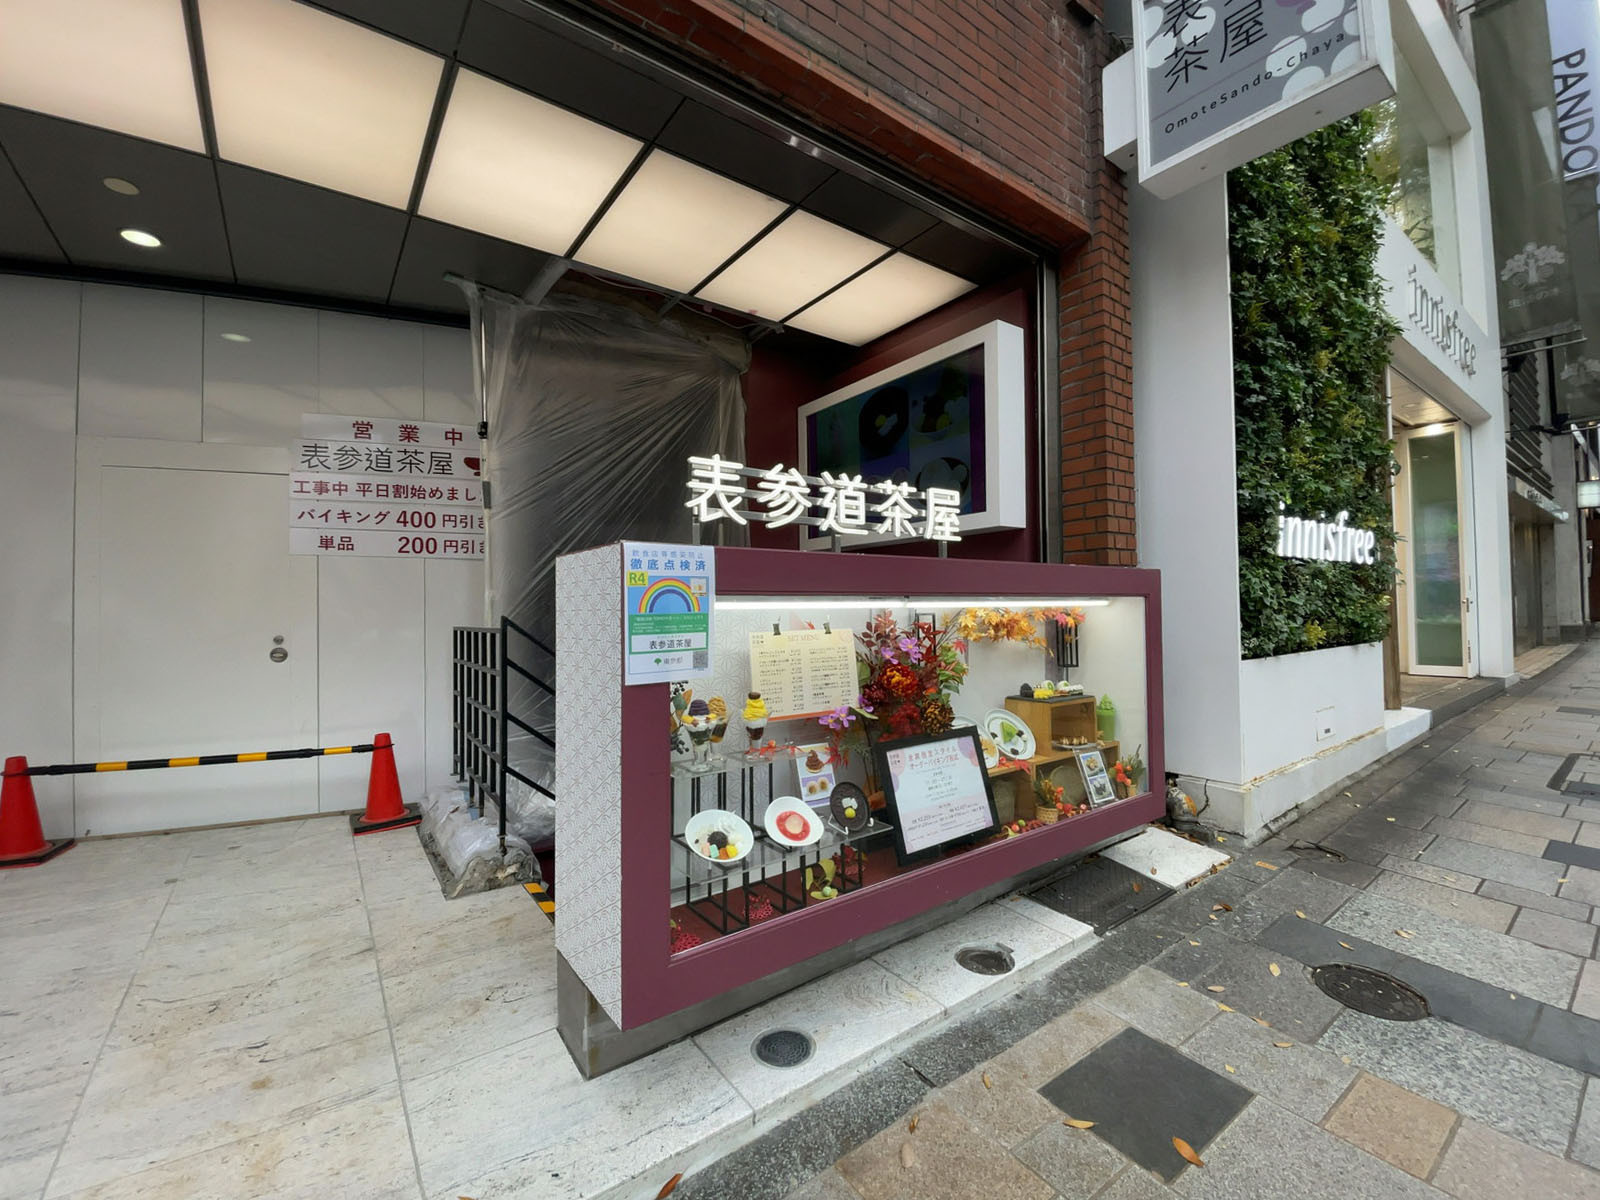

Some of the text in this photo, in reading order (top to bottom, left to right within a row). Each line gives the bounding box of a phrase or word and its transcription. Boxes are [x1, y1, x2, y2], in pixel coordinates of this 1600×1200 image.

[1165, 33, 1345, 134] OmoteSando-Chaya
[1408, 263, 1476, 378] innisfree
[352, 420, 463, 446] 営業中
[300, 443, 454, 476] 表参道茶屋
[355, 482, 482, 502] 平日割始めまし
[684, 453, 963, 542] 表参道茶屋
[318, 536, 355, 552] 単品
[1277, 500, 1375, 566] innisfree
[630, 558, 707, 572] 徹底点検済
[629, 573, 646, 584] R4
[649, 638, 692, 650] 表参道茶屋
